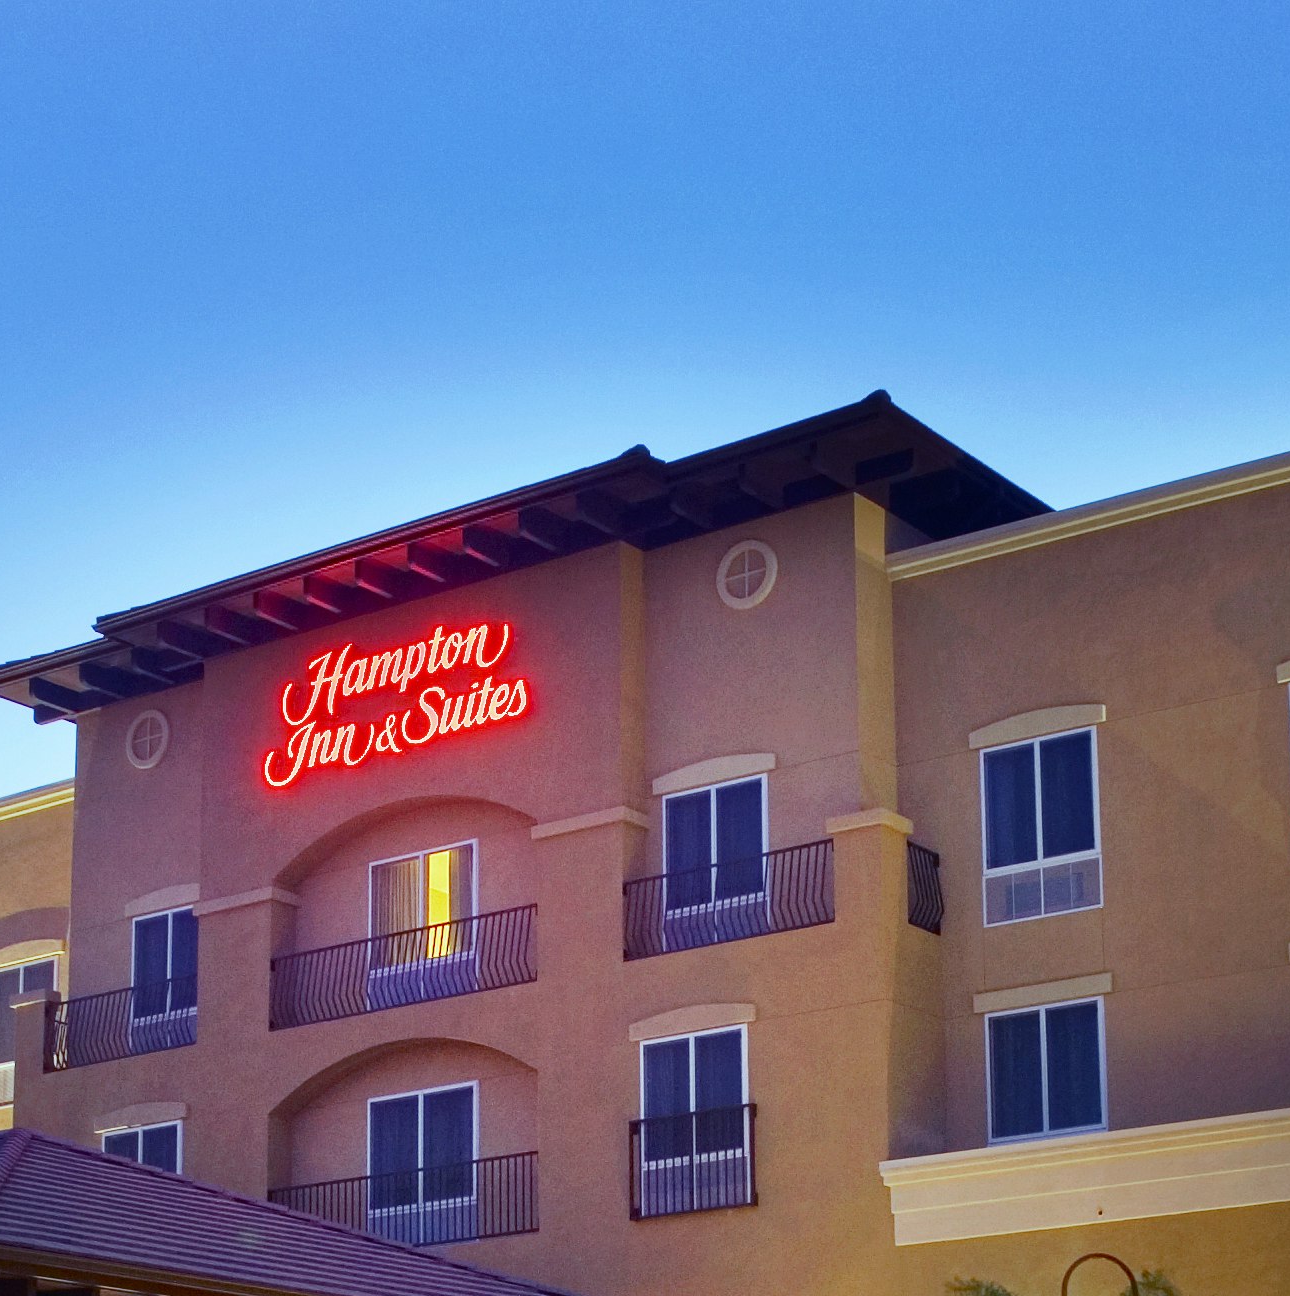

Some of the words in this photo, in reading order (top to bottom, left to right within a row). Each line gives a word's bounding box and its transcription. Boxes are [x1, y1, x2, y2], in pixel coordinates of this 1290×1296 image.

[282, 623, 509, 726] Hampton
[264, 721, 375, 787] Inn
[375, 713, 403, 753] &
[401, 675, 528, 744] Suites
